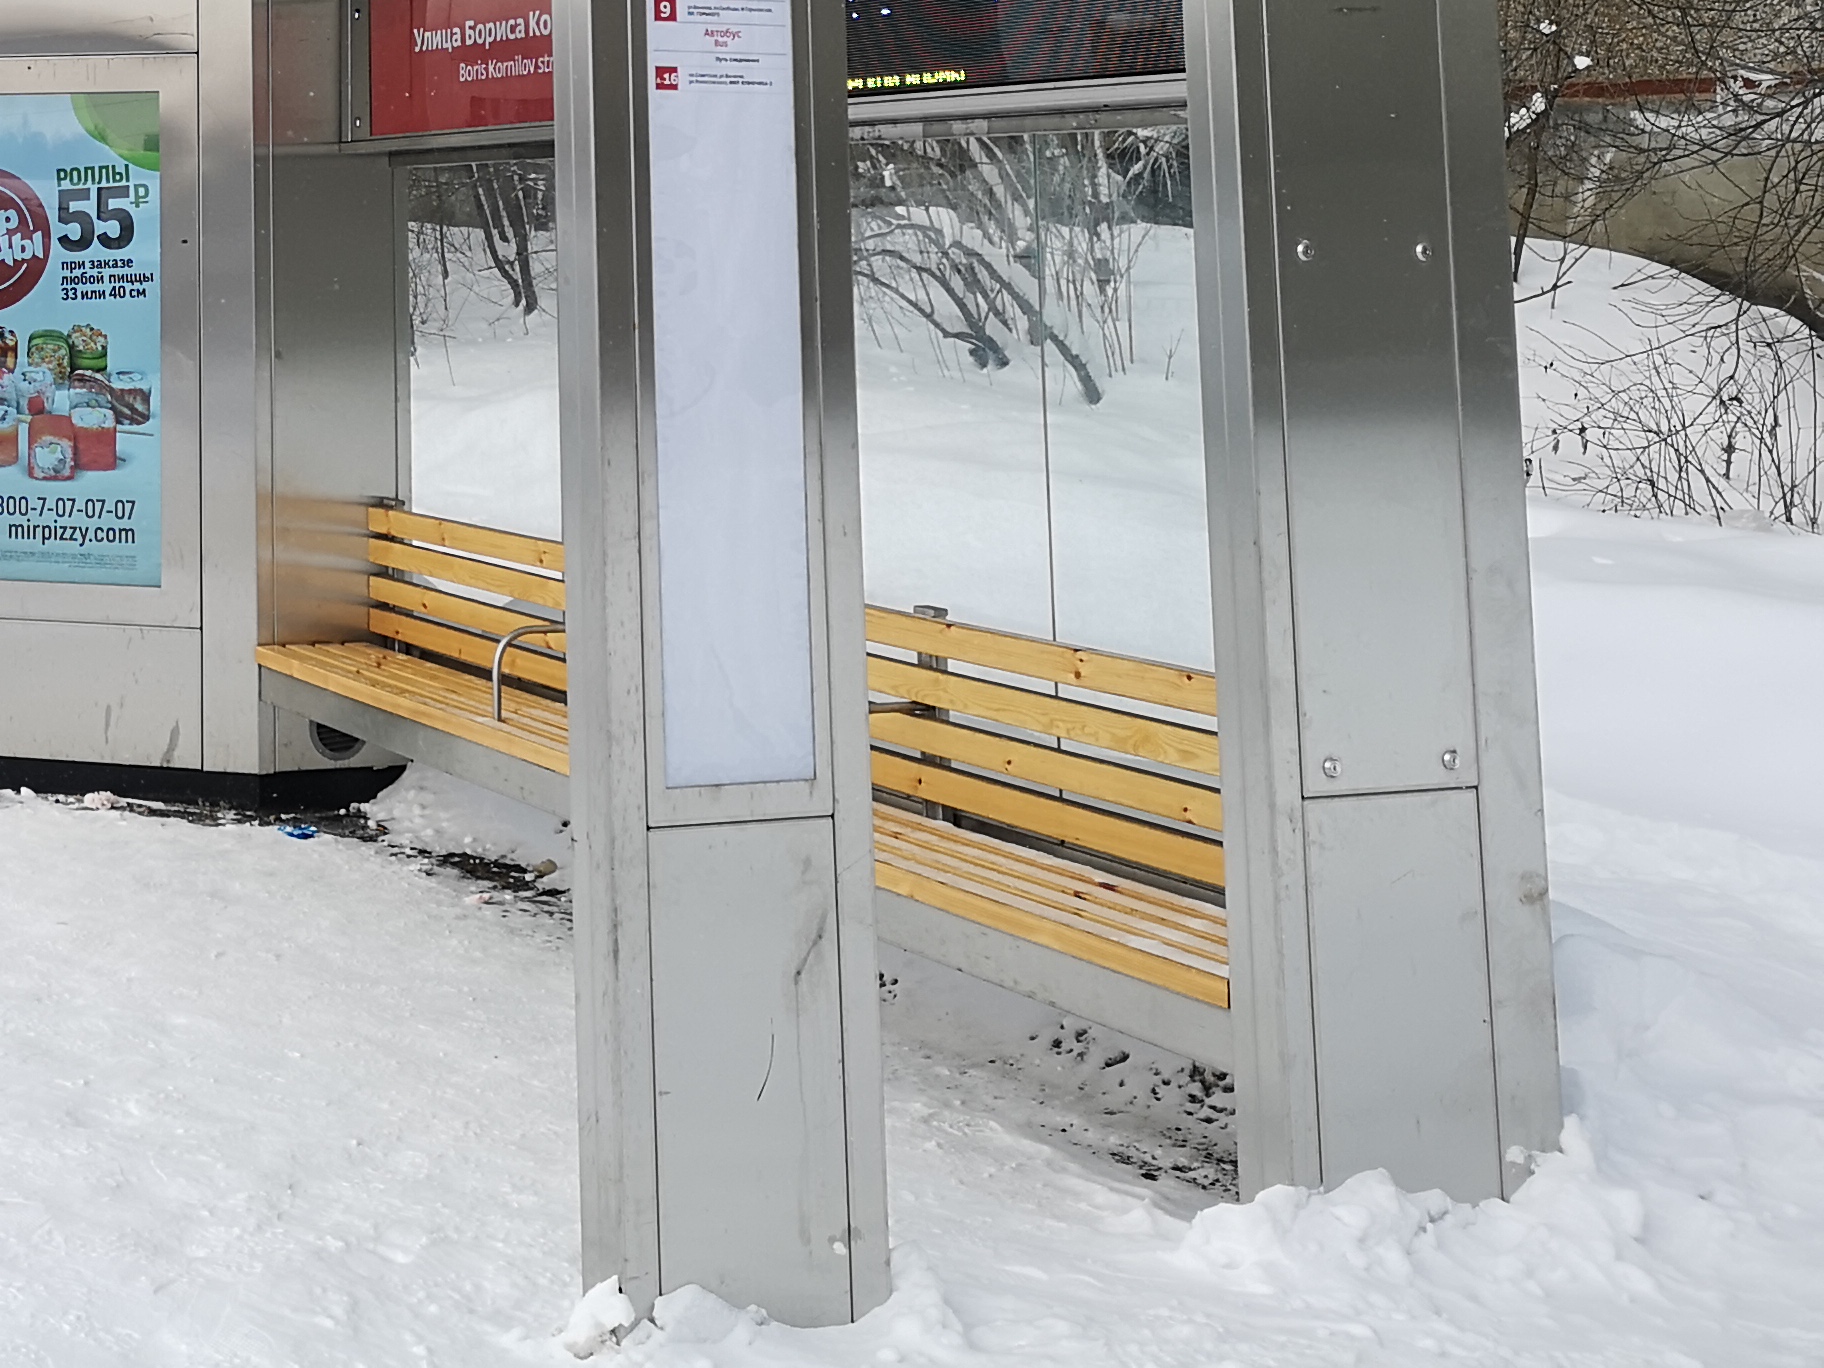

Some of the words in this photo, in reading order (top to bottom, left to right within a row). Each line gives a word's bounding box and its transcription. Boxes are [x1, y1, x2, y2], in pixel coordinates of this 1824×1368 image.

[659, 1, 671, 17] 9
[413, 27, 461, 52] Улица
[465, 18, 526, 49] Бориса
[704, 28, 742, 41] Автобус
[714, 39, 728, 48] Bus
[459, 60, 487, 82] Boris
[488, 54, 536, 79] Kornilov
[56, 164, 130, 187] РОЛЛЫ
[61, 260, 85, 273] при
[88, 258, 133, 269] заказе
[61, 271, 104, 286] любой
[109, 273, 154, 285] пиццы
[61, 287, 78, 300] 33
[81, 289, 106, 300] или
[109, 285, 126, 298] 40
[129, 288, 146, 298] см
[8, 518, 135, 547] mirpizzy.com
